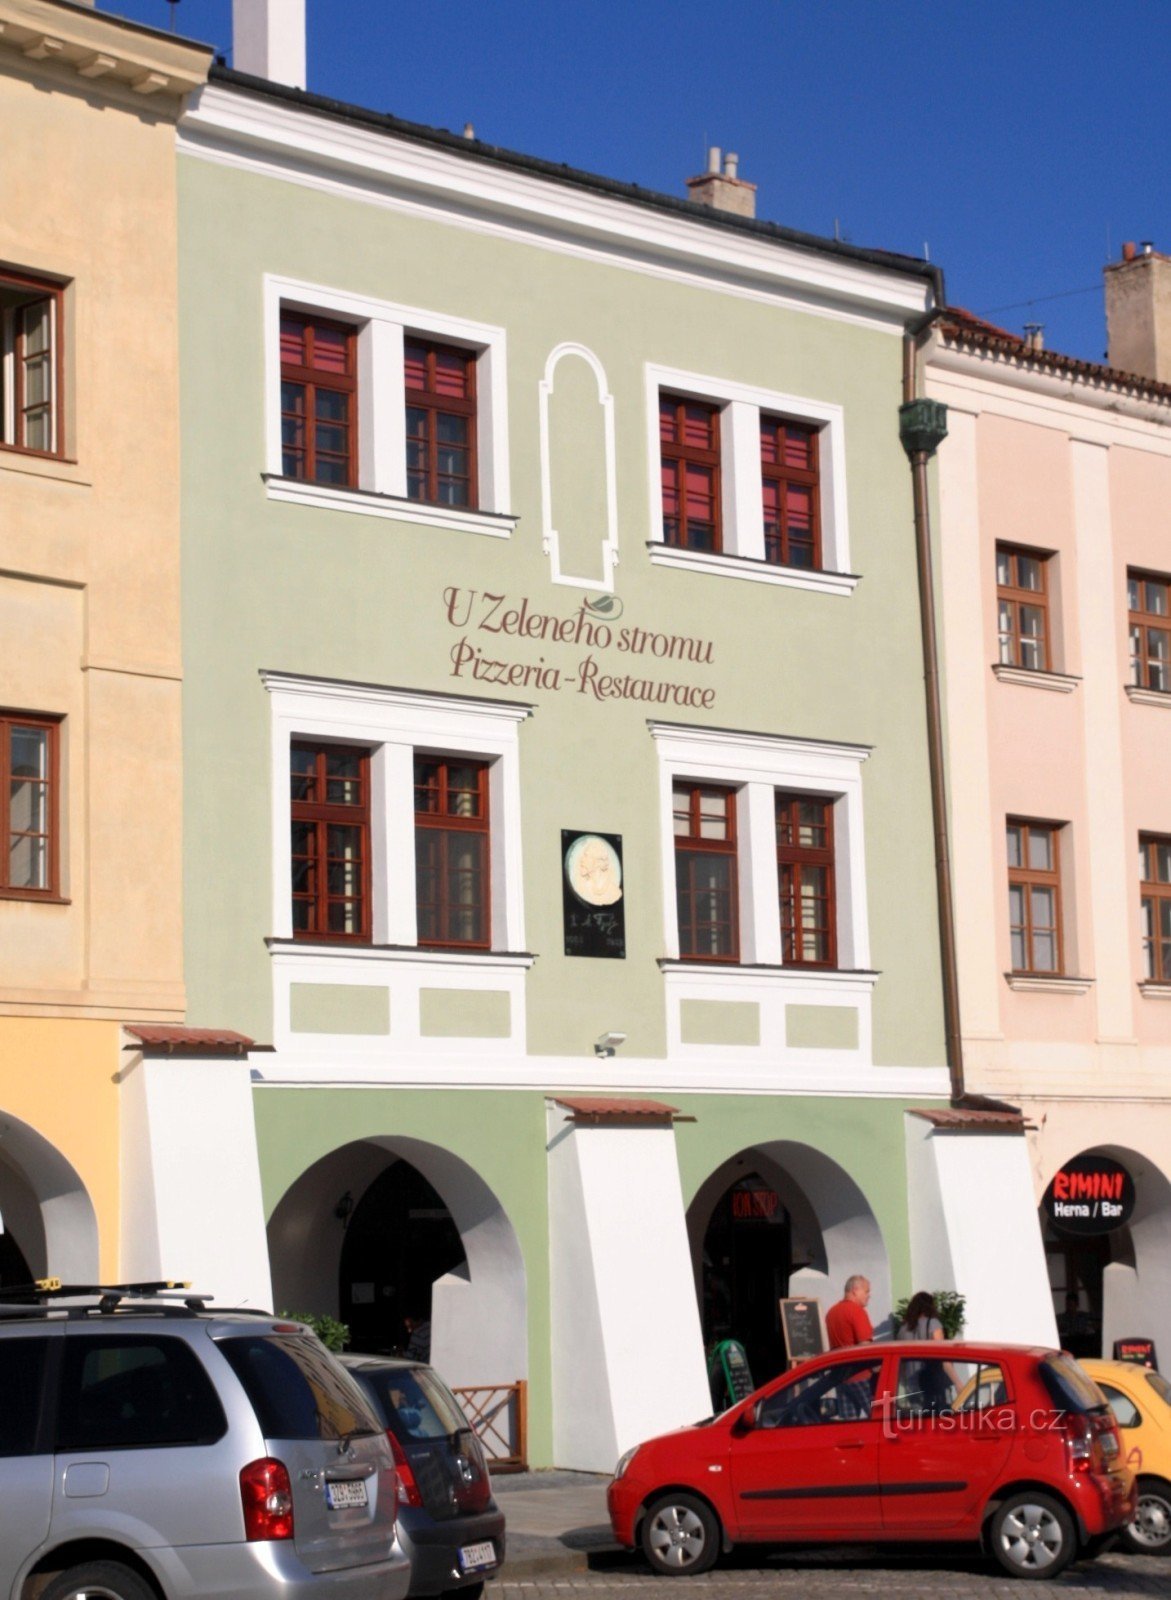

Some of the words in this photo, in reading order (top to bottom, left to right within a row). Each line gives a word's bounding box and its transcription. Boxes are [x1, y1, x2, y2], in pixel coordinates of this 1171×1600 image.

[443, 587, 477, 627] U
[616, 626, 716, 664] stromu
[1053, 1170, 1124, 1200] RIMINI
[1054, 1201, 1090, 1217] Herna
[1101, 1201, 1123, 1217] Bar
